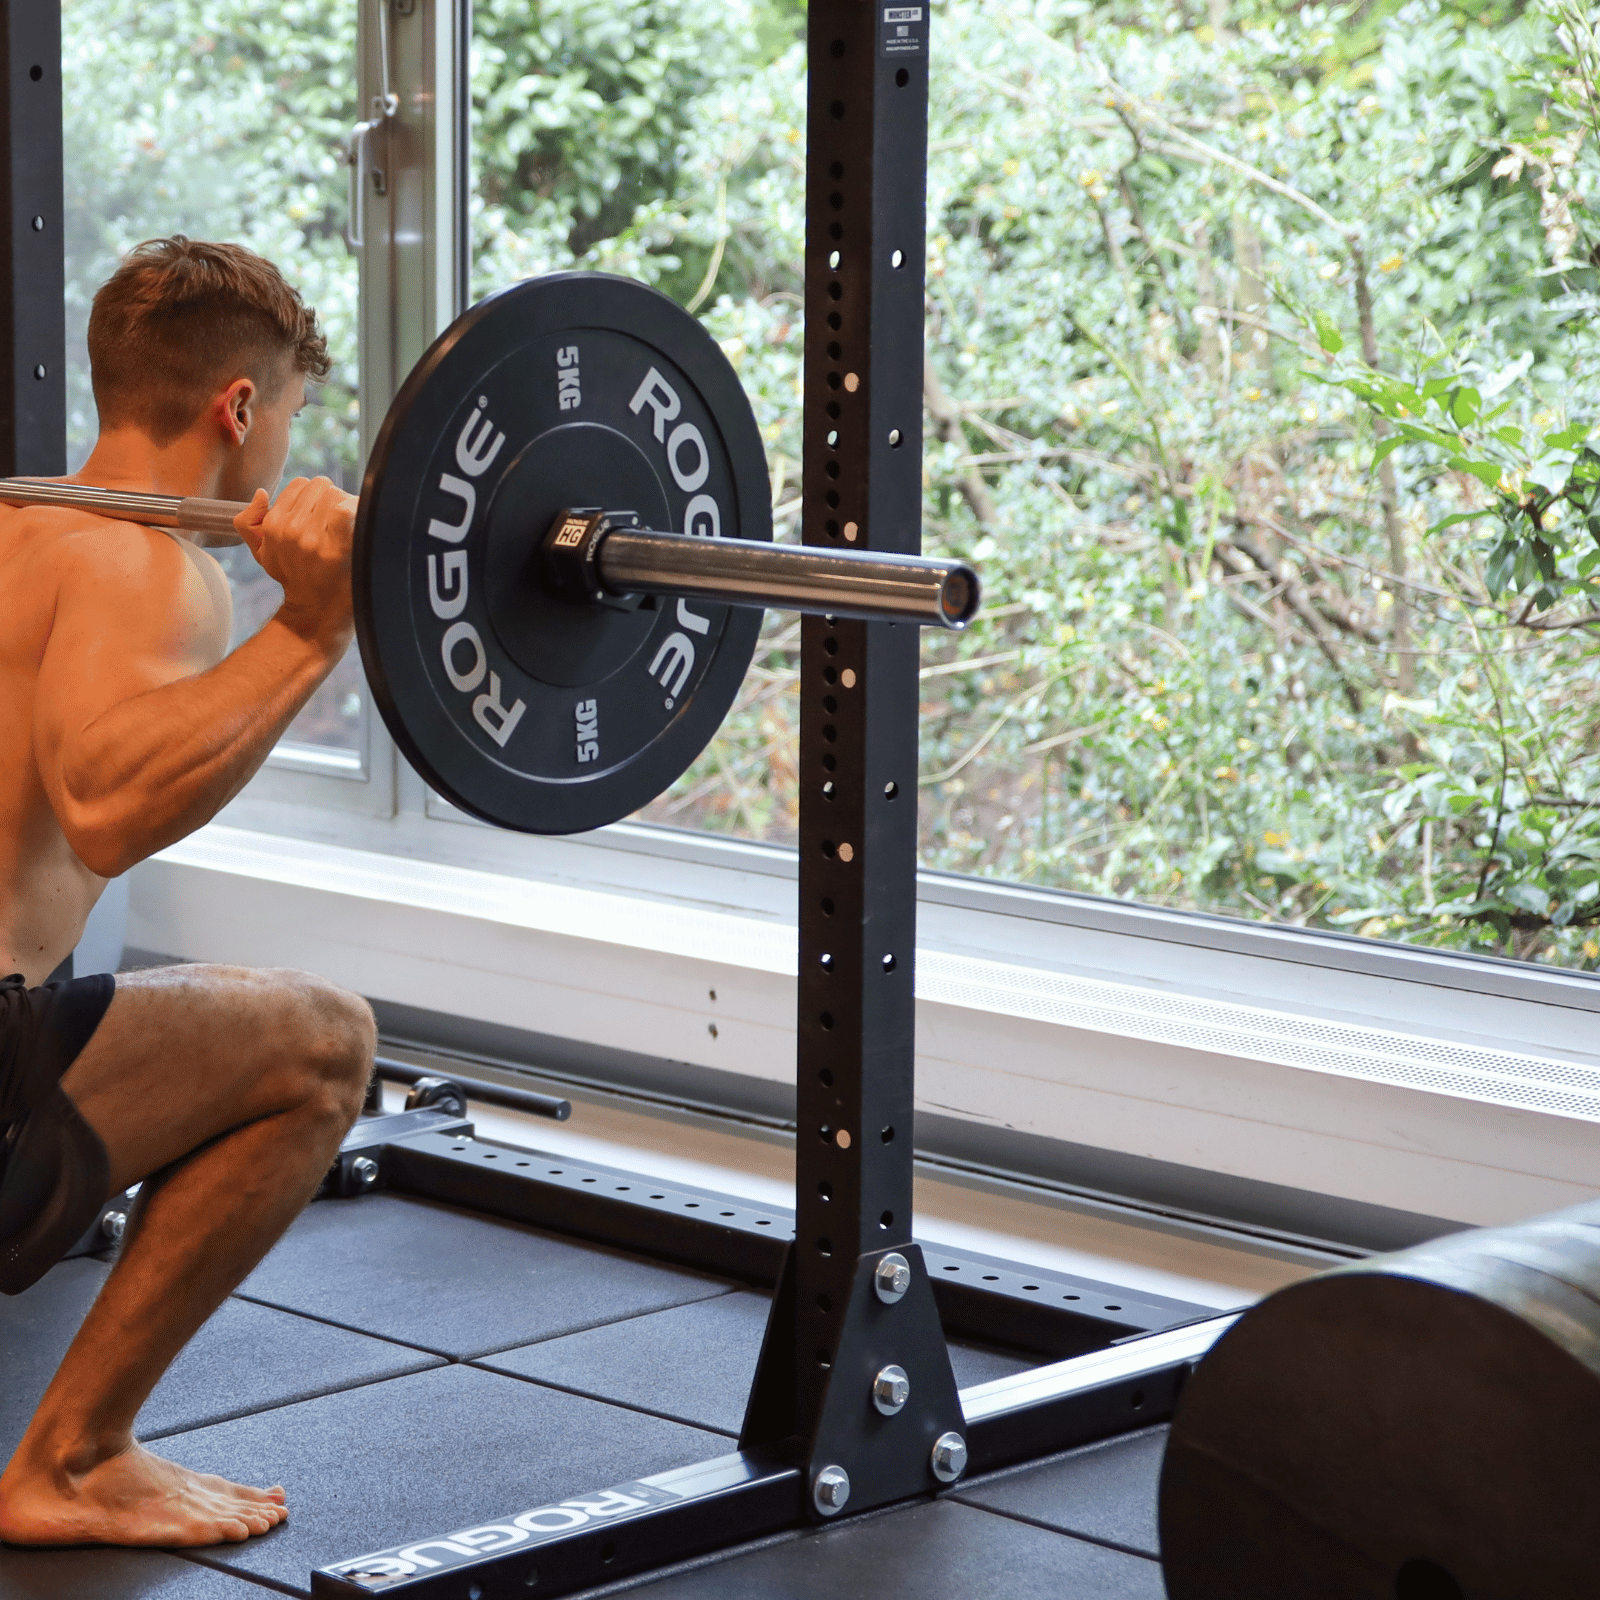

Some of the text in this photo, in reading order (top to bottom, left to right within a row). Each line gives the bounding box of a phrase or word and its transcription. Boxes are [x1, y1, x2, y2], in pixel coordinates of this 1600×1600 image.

[556, 346, 581, 410] 5KG
[428, 407, 526, 748] ROGUE
[575, 699, 599, 763] 5KG
